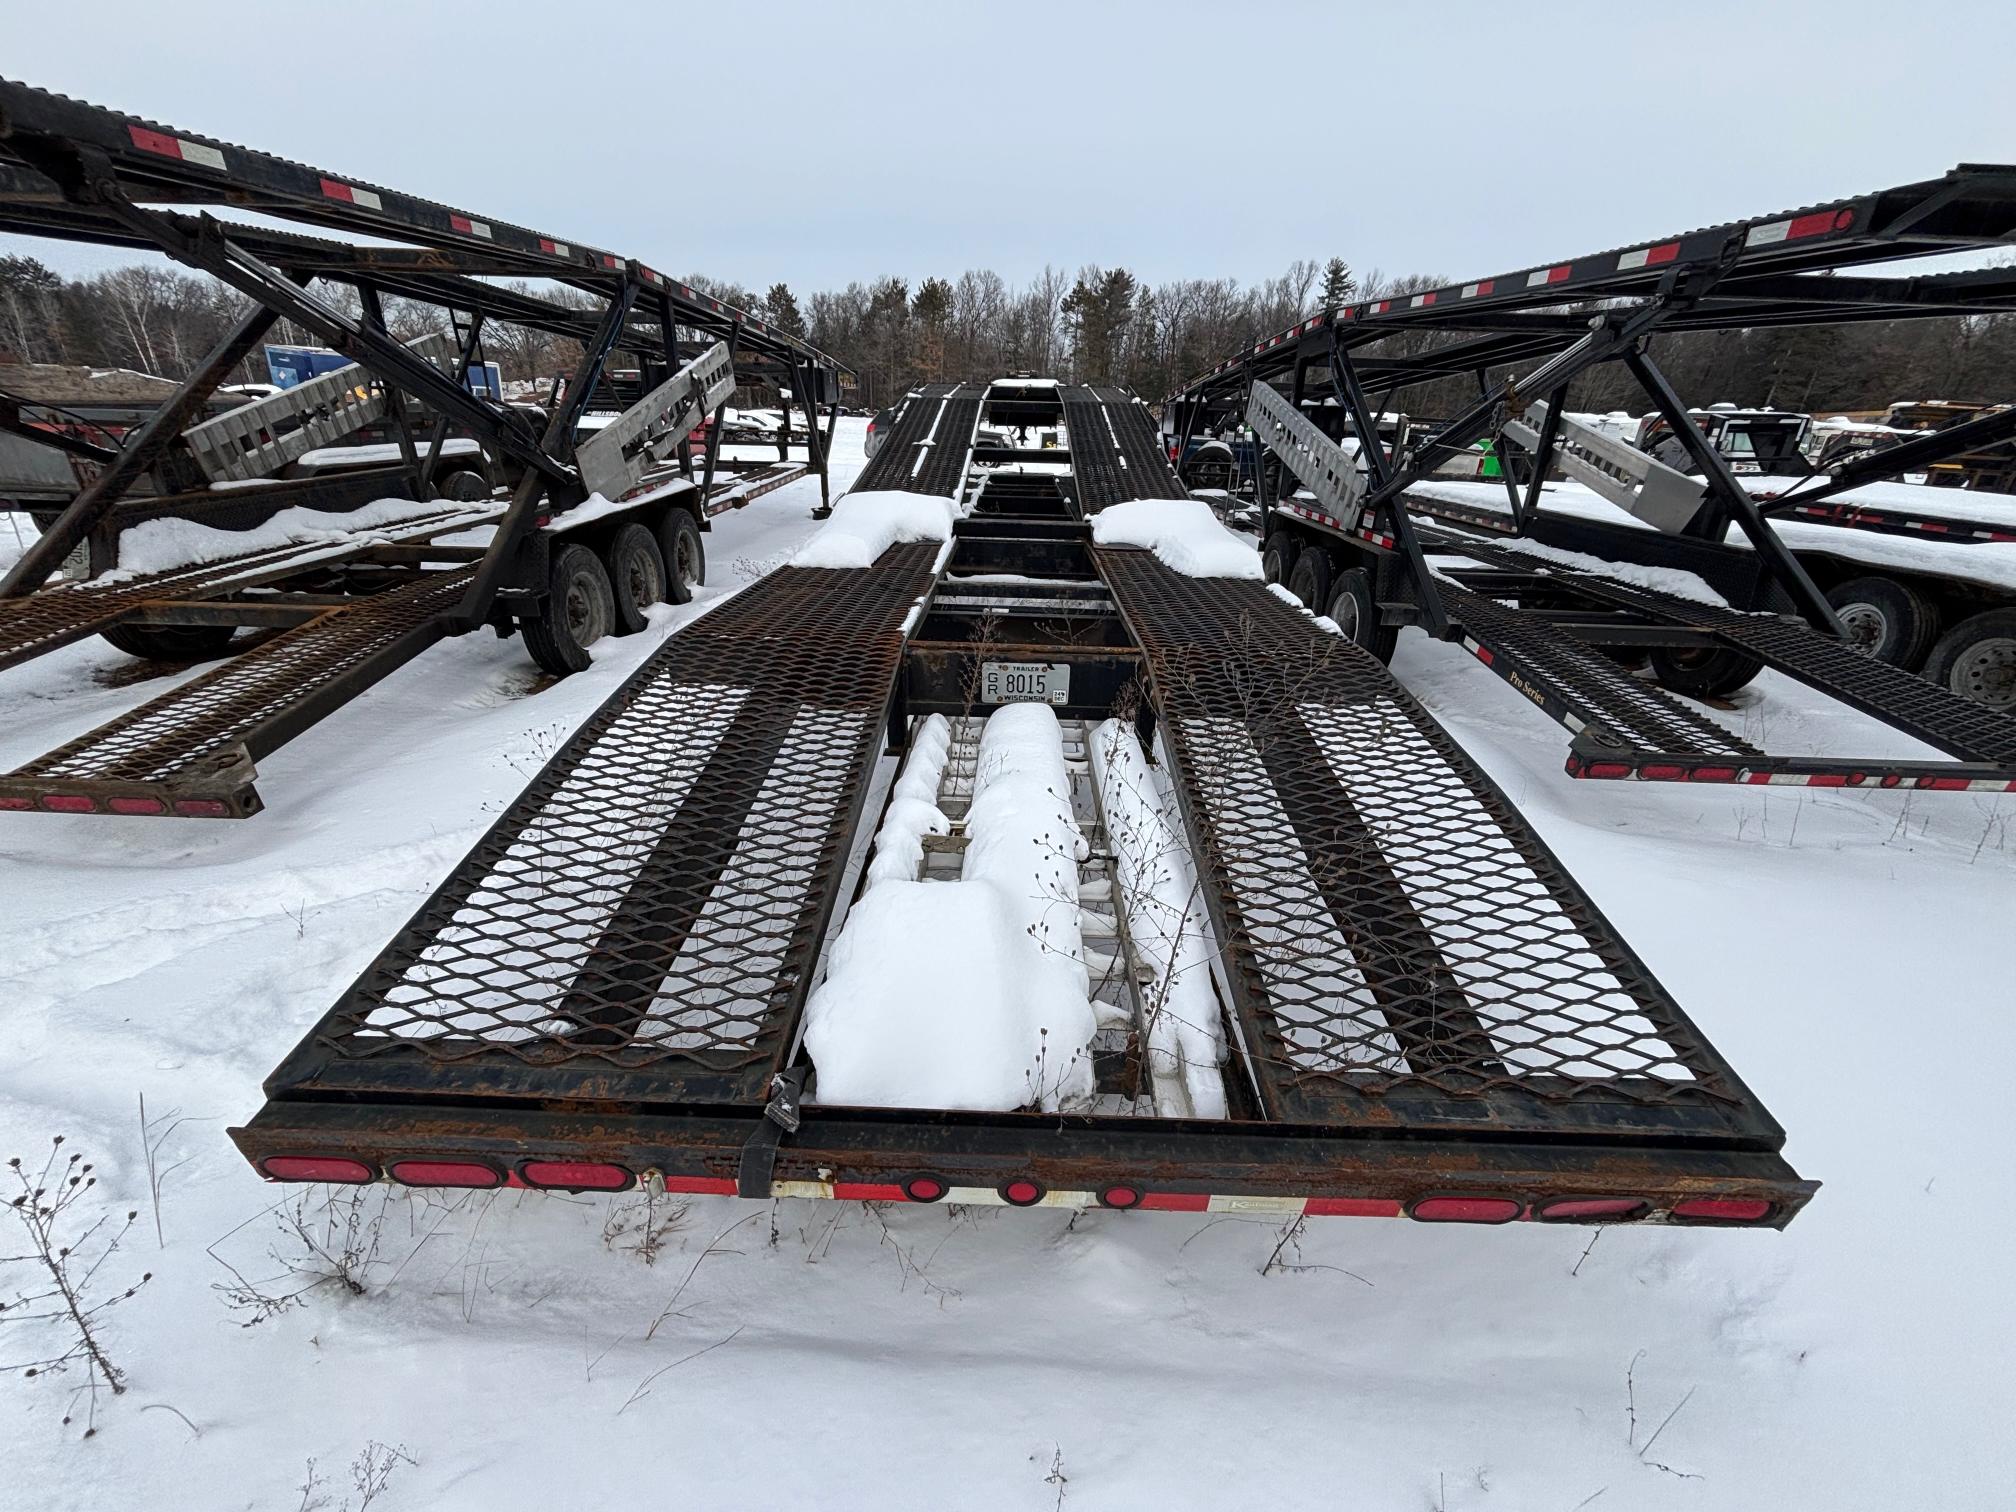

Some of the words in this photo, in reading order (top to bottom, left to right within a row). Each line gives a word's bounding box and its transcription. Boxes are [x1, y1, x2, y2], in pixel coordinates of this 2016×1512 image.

[1006, 673, 1046, 695] 8015
[1510, 671, 1523, 687] Pro
[1522, 681, 1545, 705] Series
[1004, 694, 1046, 702] WISCONSIN
